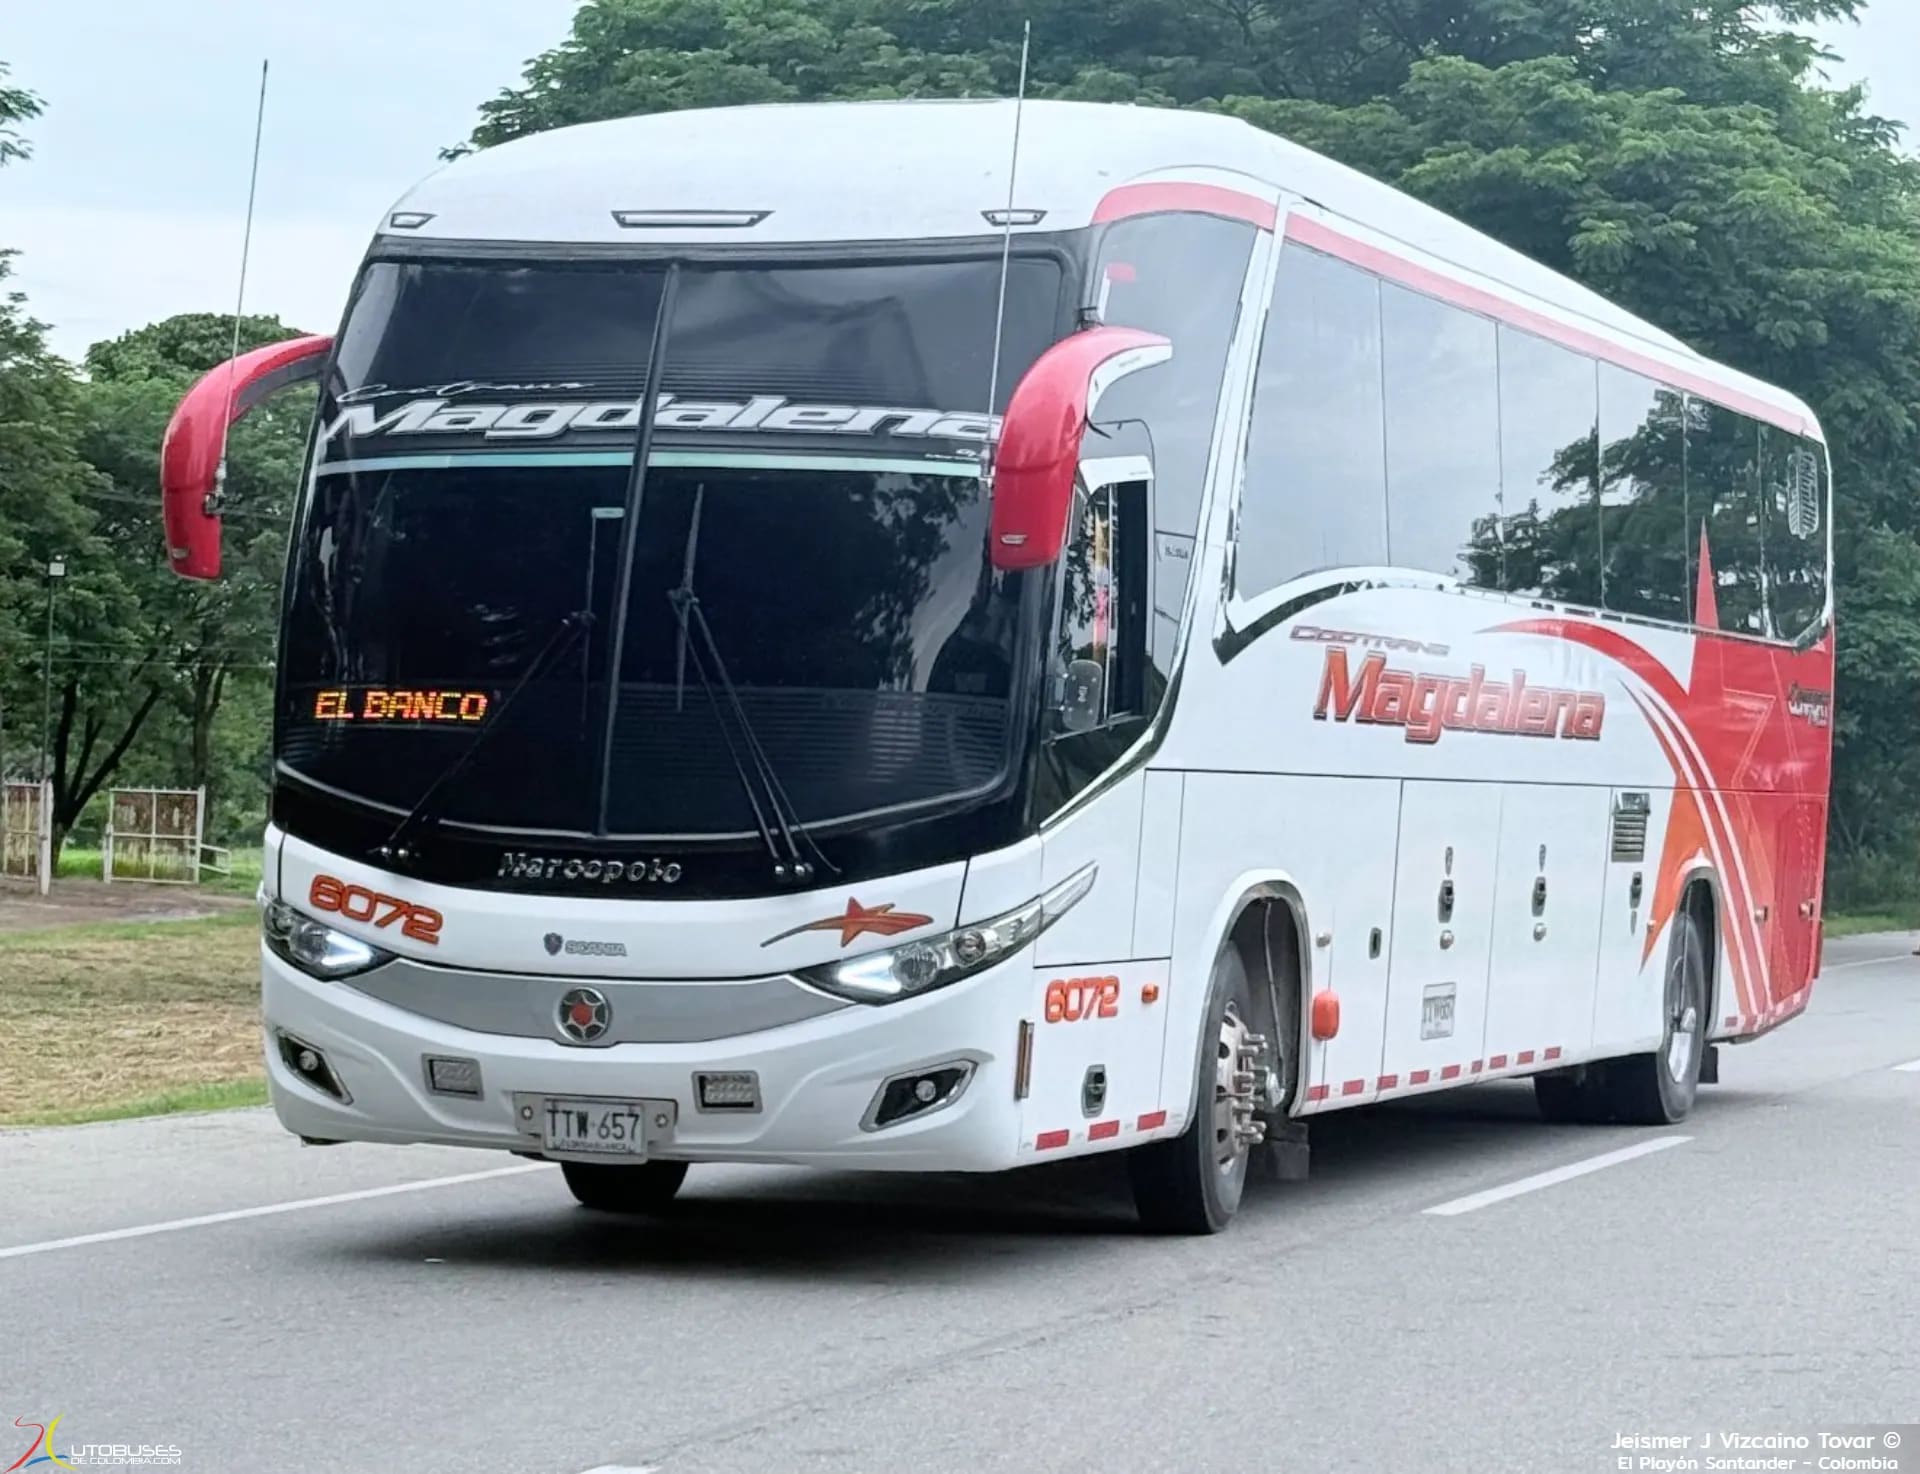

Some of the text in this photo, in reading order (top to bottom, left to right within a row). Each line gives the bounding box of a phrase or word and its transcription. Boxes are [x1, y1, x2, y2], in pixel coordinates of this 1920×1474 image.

[321, 393, 1004, 442] Magdalena
[315, 691, 488, 721] EL BANCO
[1313, 645, 1605, 744] Magdalena
[498, 852, 682, 884] Marcopolo
[309, 874, 444, 945] 6072
[565, 940, 628, 957] SCANIA
[1045, 975, 1120, 1024] 6072
[547, 1109, 640, 1141] TTW 657
